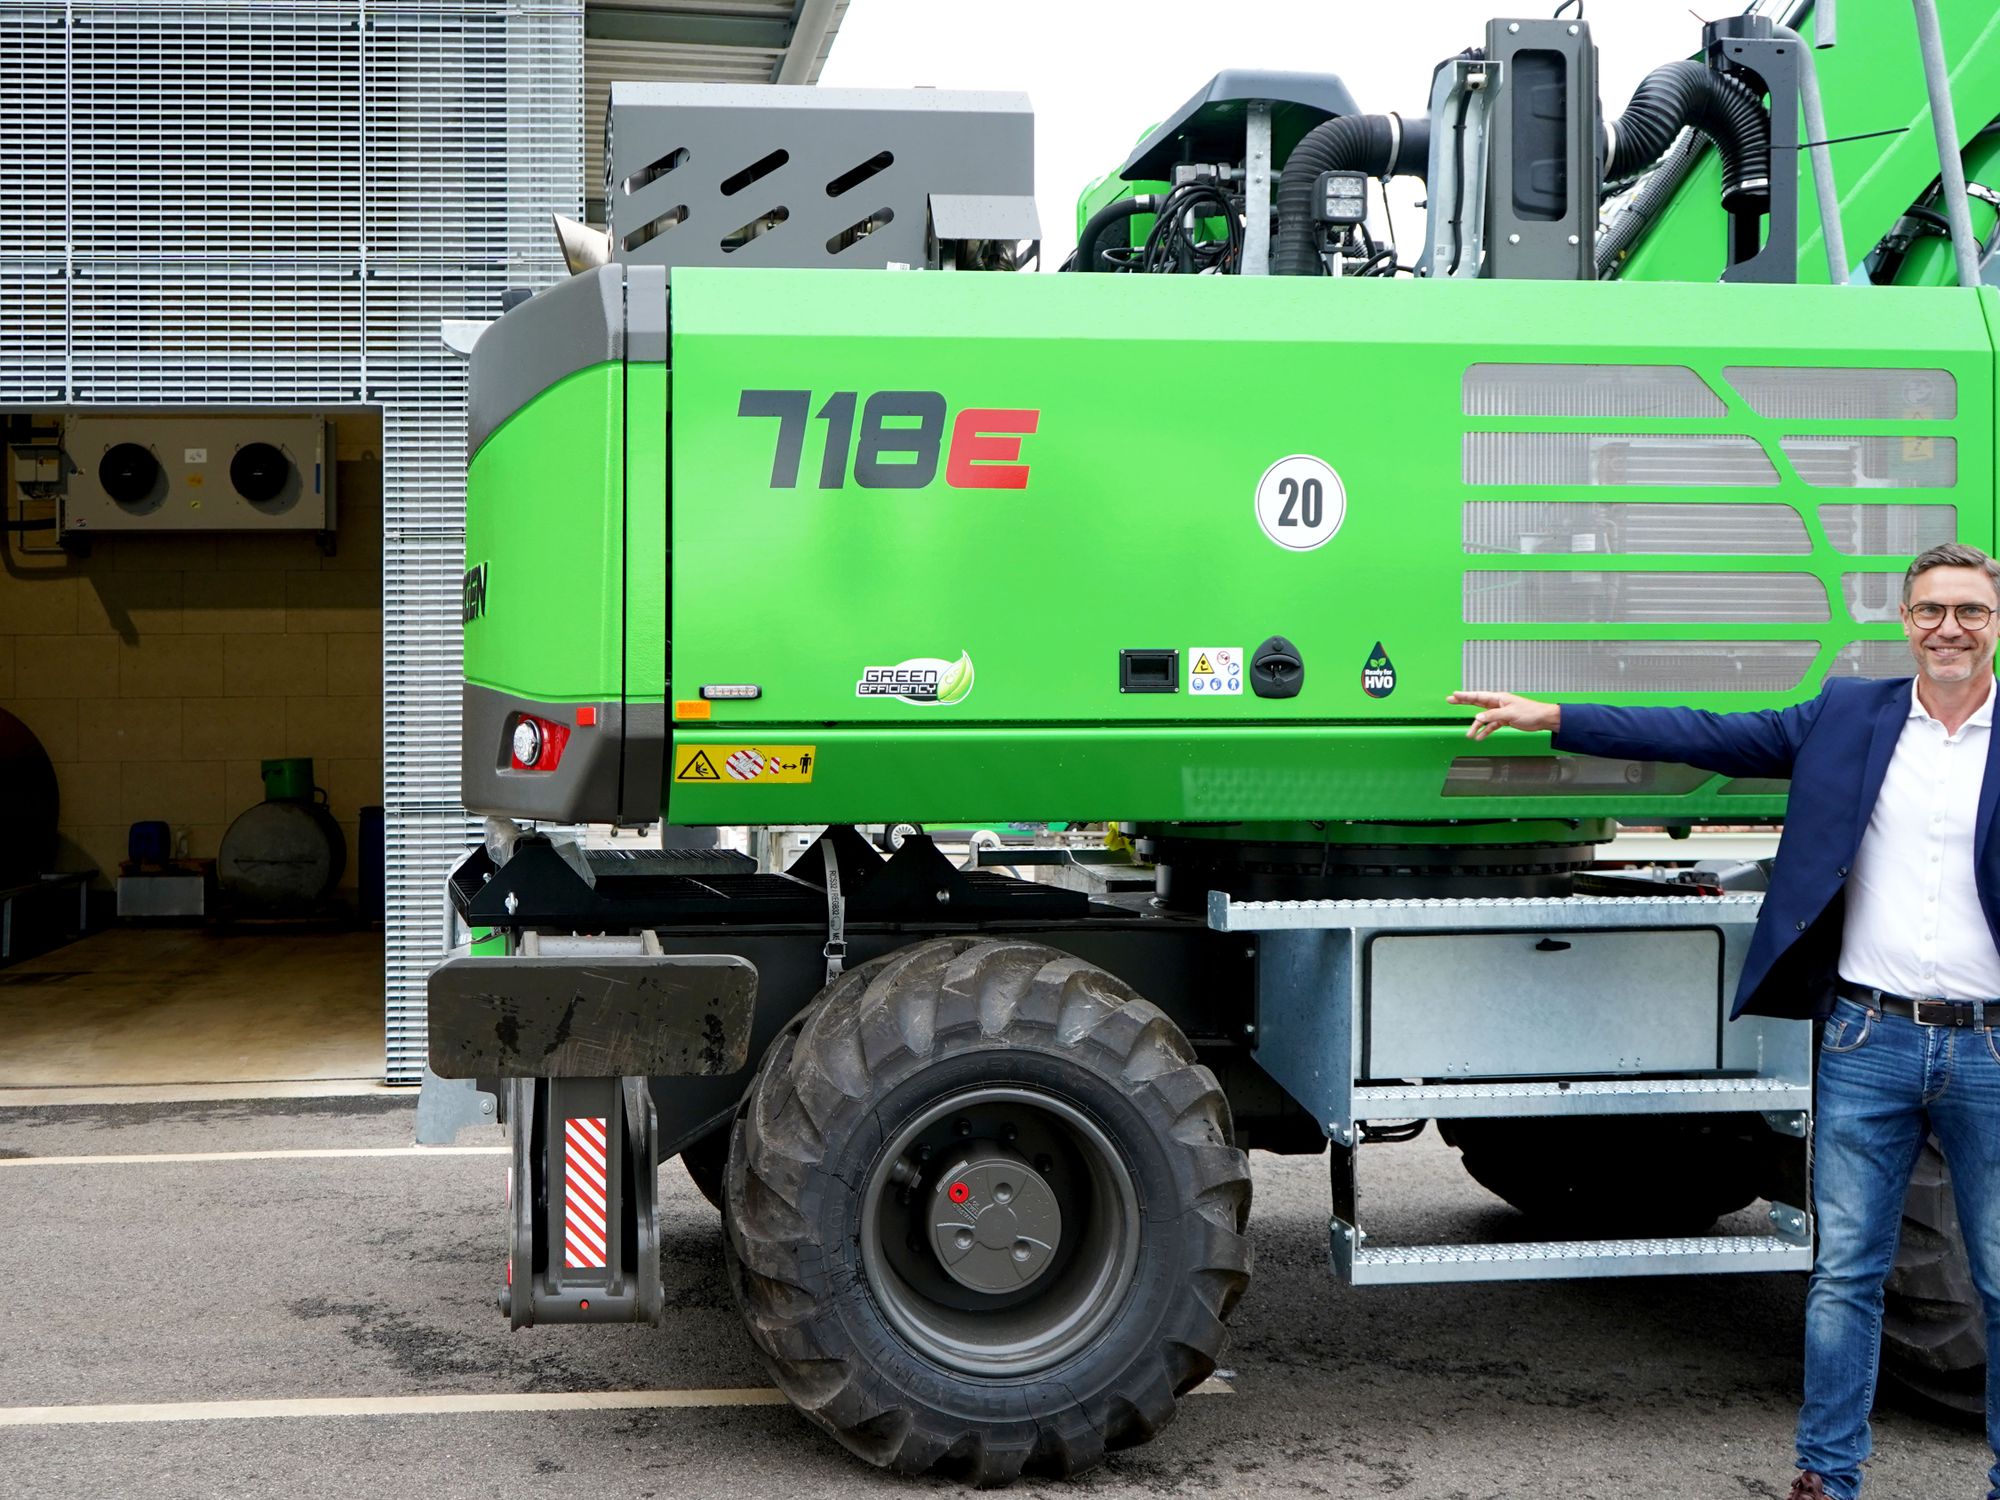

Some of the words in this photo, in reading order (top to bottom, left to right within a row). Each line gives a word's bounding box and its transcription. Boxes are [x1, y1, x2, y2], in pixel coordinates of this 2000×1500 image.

[737, 390, 1040, 489] 718E
[1278, 477, 1323, 528] 20
[866, 670, 938, 682] GREEN
[1365, 676, 1393, 689] HVO
[859, 684, 937, 694] EFFICIENCY
